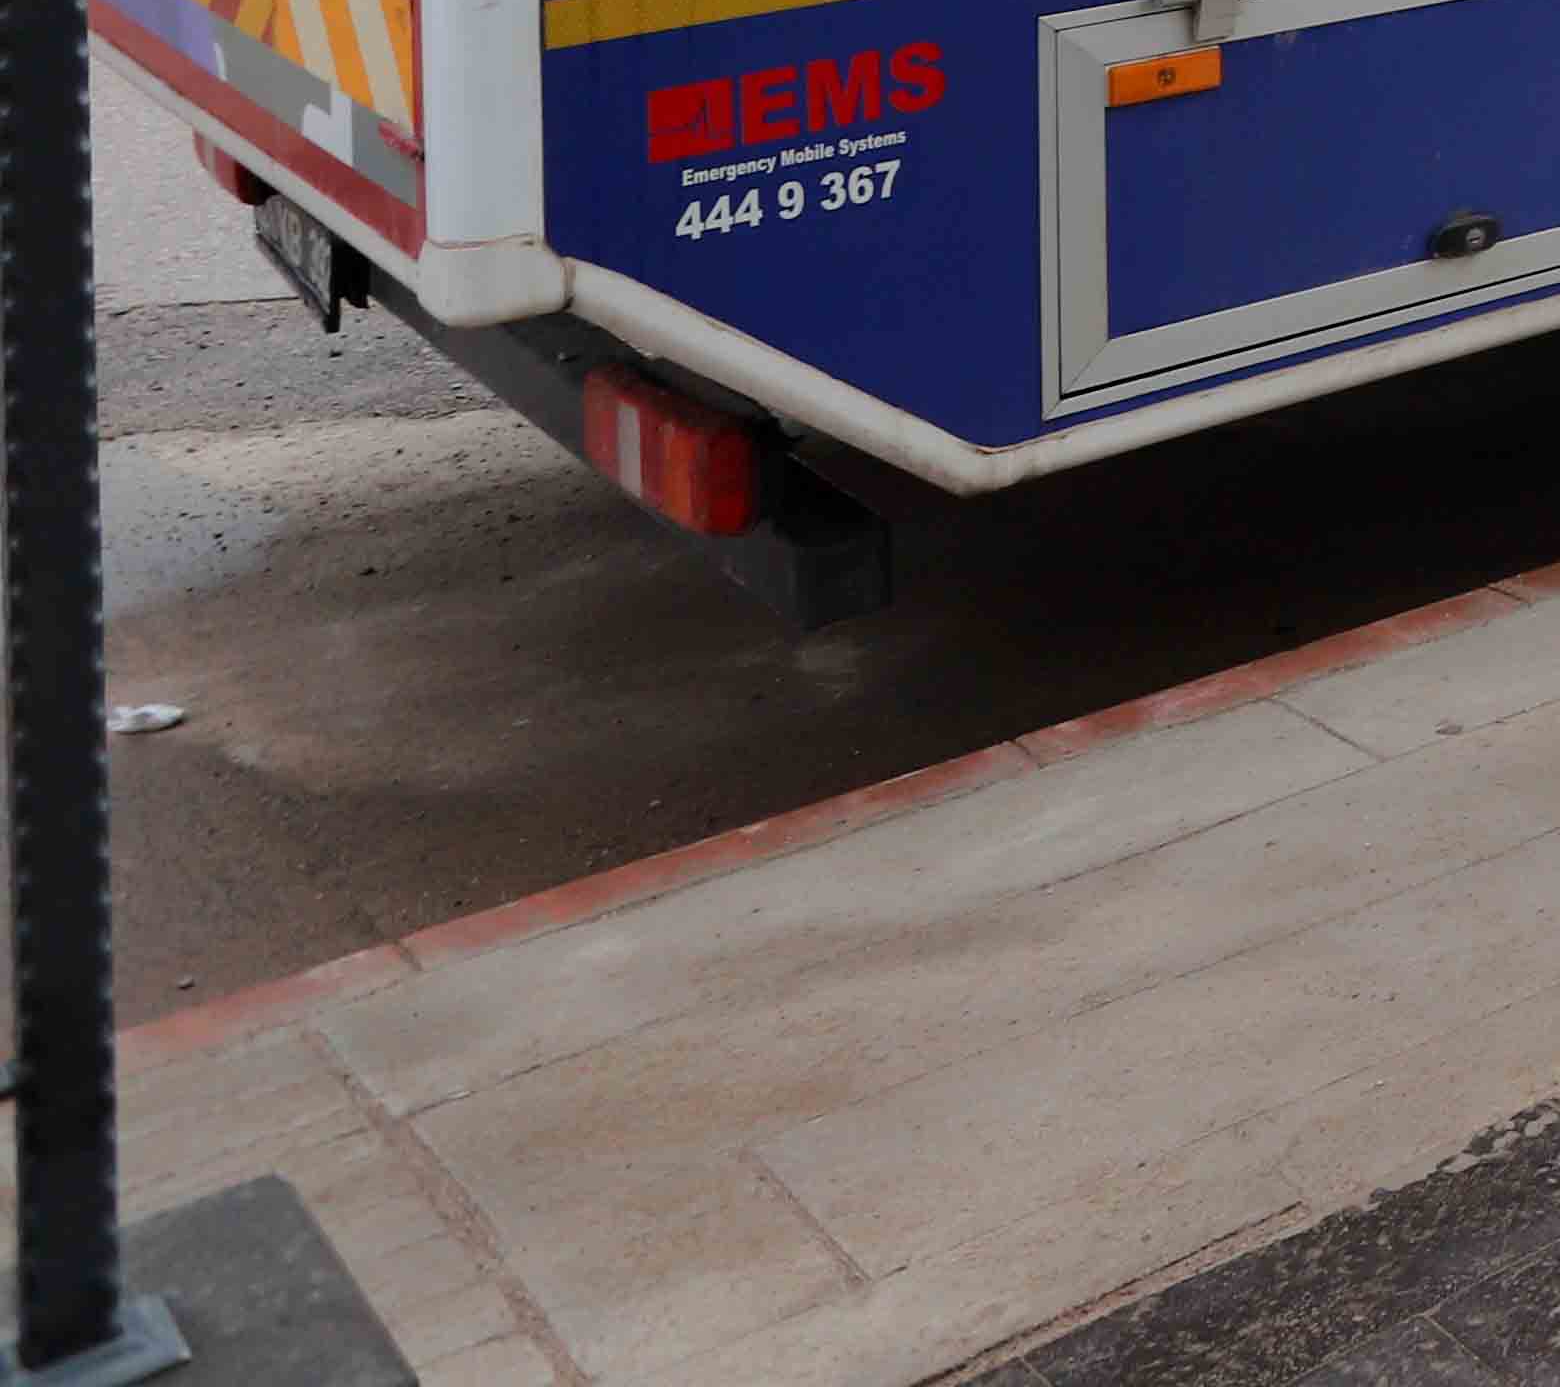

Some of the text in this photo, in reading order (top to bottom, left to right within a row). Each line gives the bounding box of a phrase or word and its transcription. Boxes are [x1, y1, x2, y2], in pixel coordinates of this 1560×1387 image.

[740, 41, 947, 145] EMS
[681, 130, 907, 187] Emergency Mobile Systems
[675, 159, 901, 241] 444 9 367
